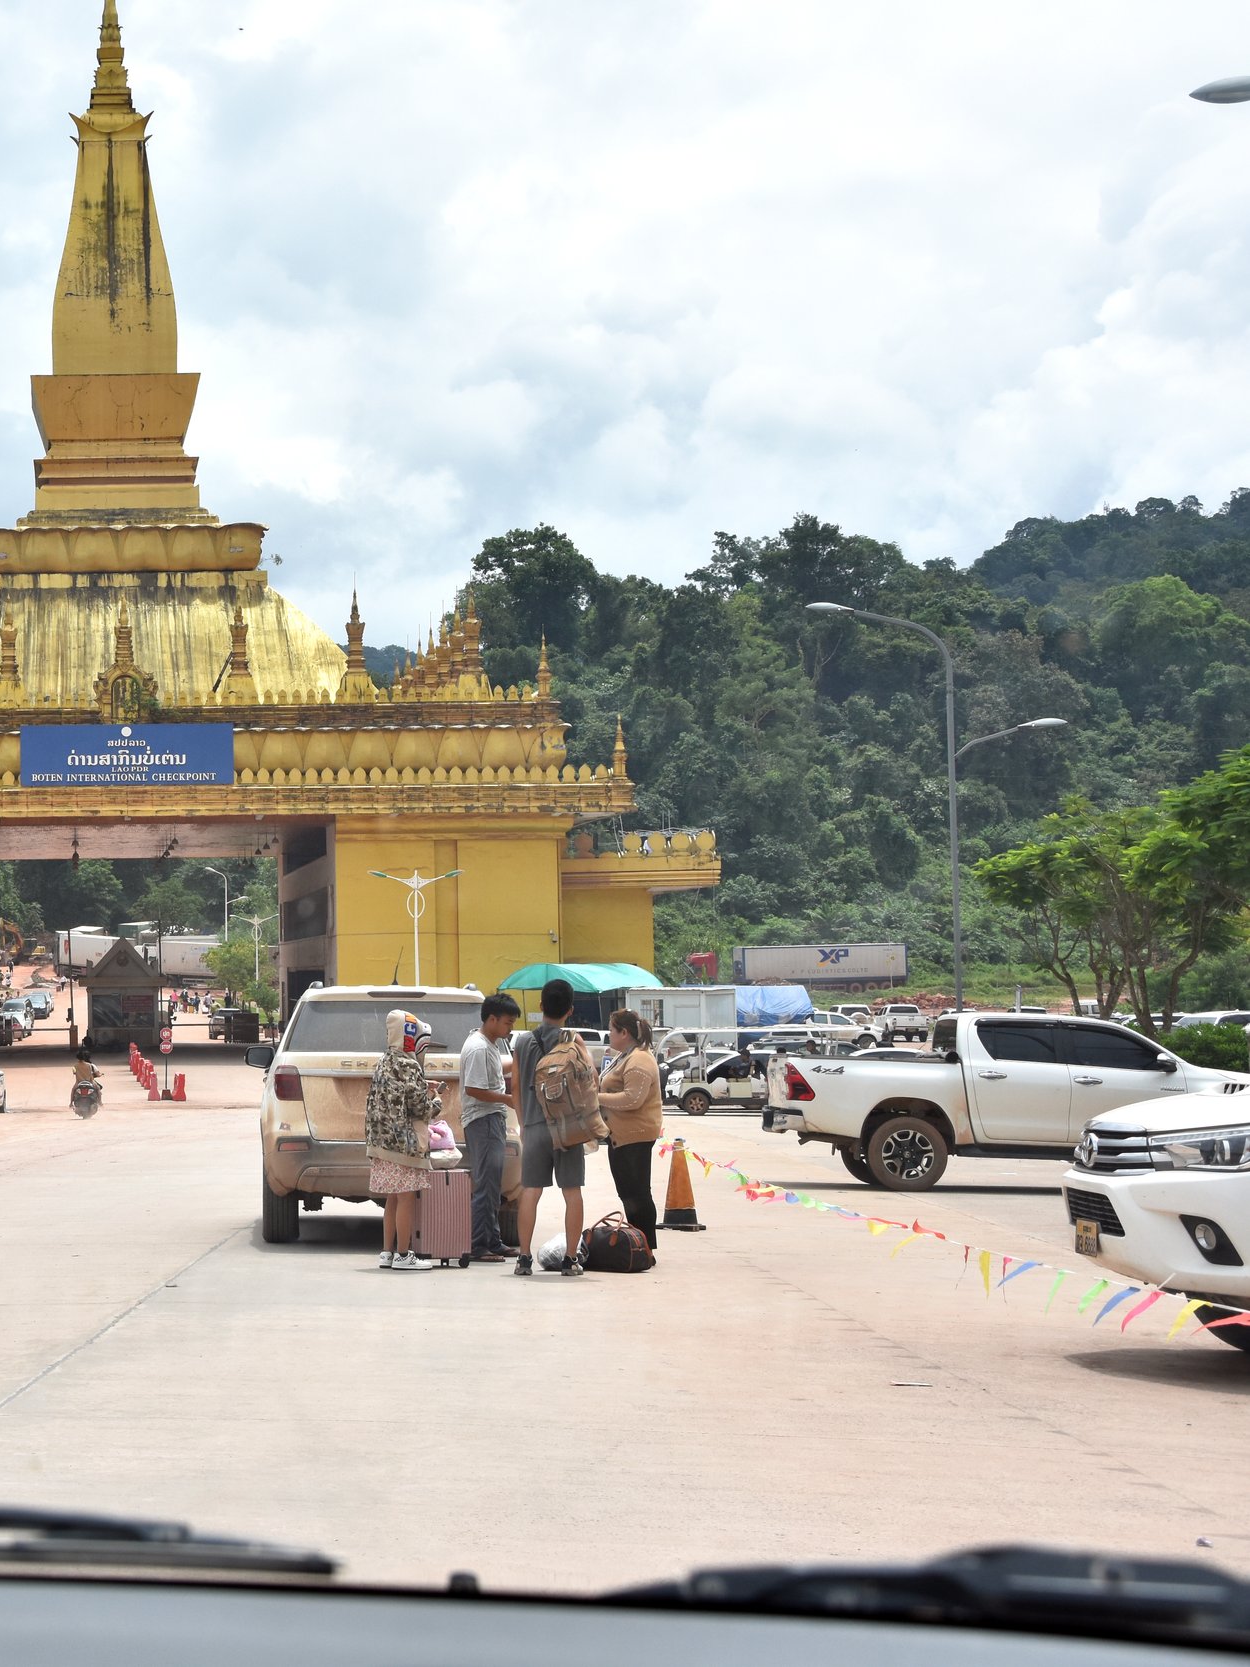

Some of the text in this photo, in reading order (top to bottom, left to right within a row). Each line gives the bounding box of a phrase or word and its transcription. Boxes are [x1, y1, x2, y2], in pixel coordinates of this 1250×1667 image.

[31, 772, 217, 782] BOTEN INTERNATIONAL CHECKPOINT
